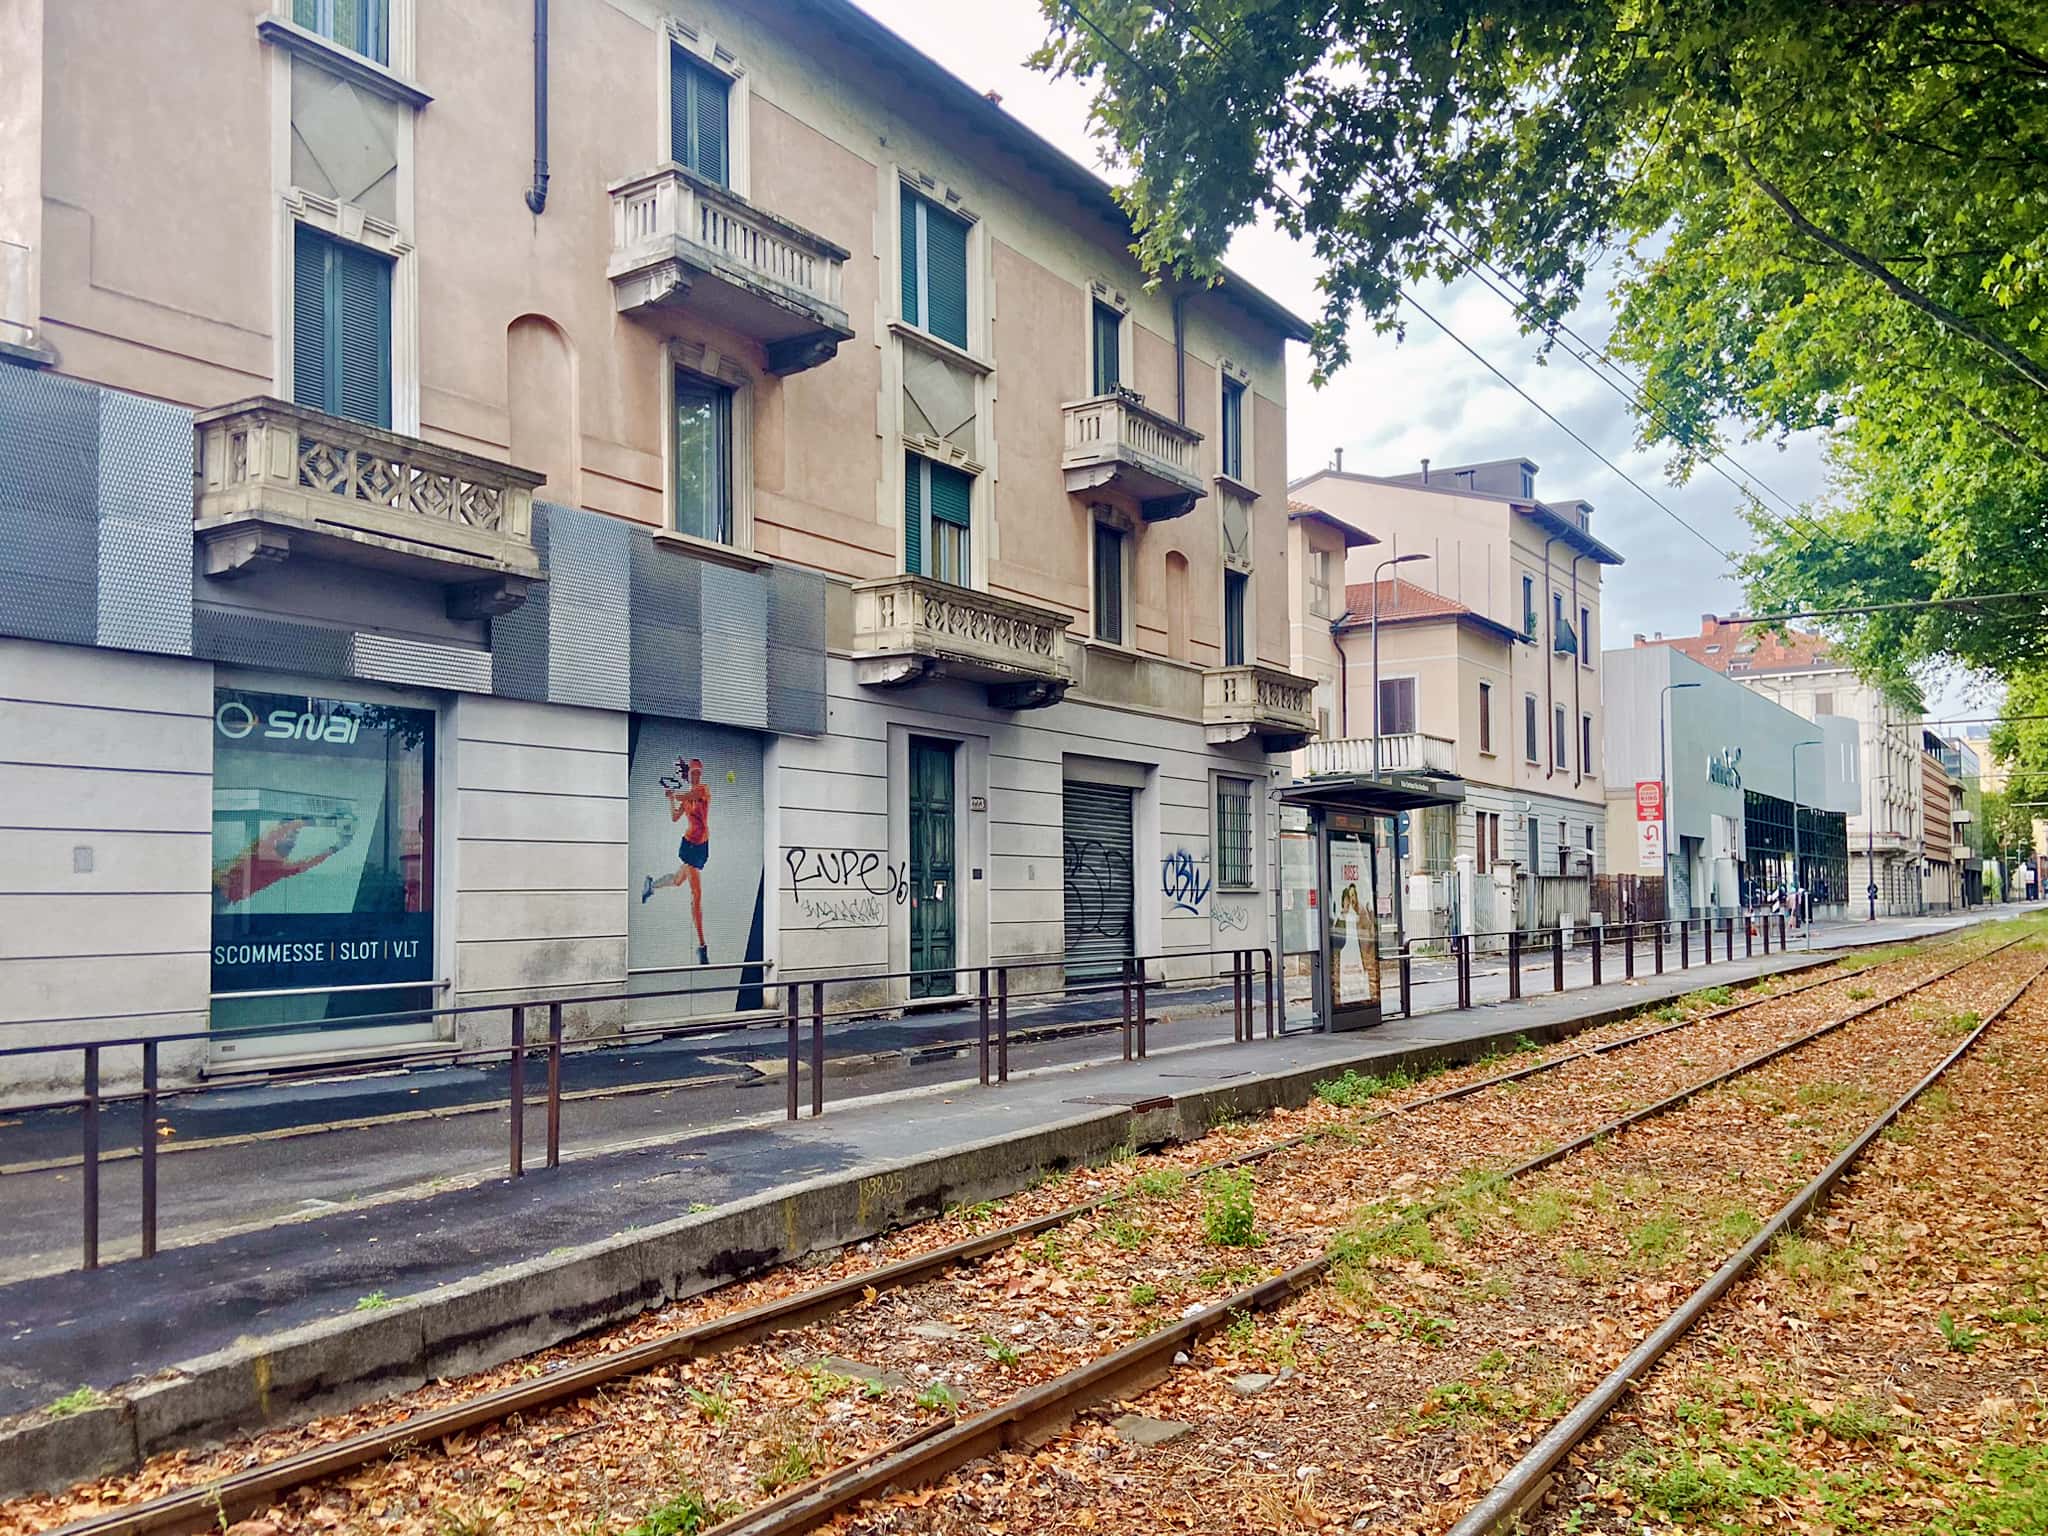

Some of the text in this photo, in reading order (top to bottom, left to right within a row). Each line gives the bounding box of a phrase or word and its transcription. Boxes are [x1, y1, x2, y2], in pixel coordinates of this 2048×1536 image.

[214, 940, 419, 965] SCOMMESSE SLOT VLT
